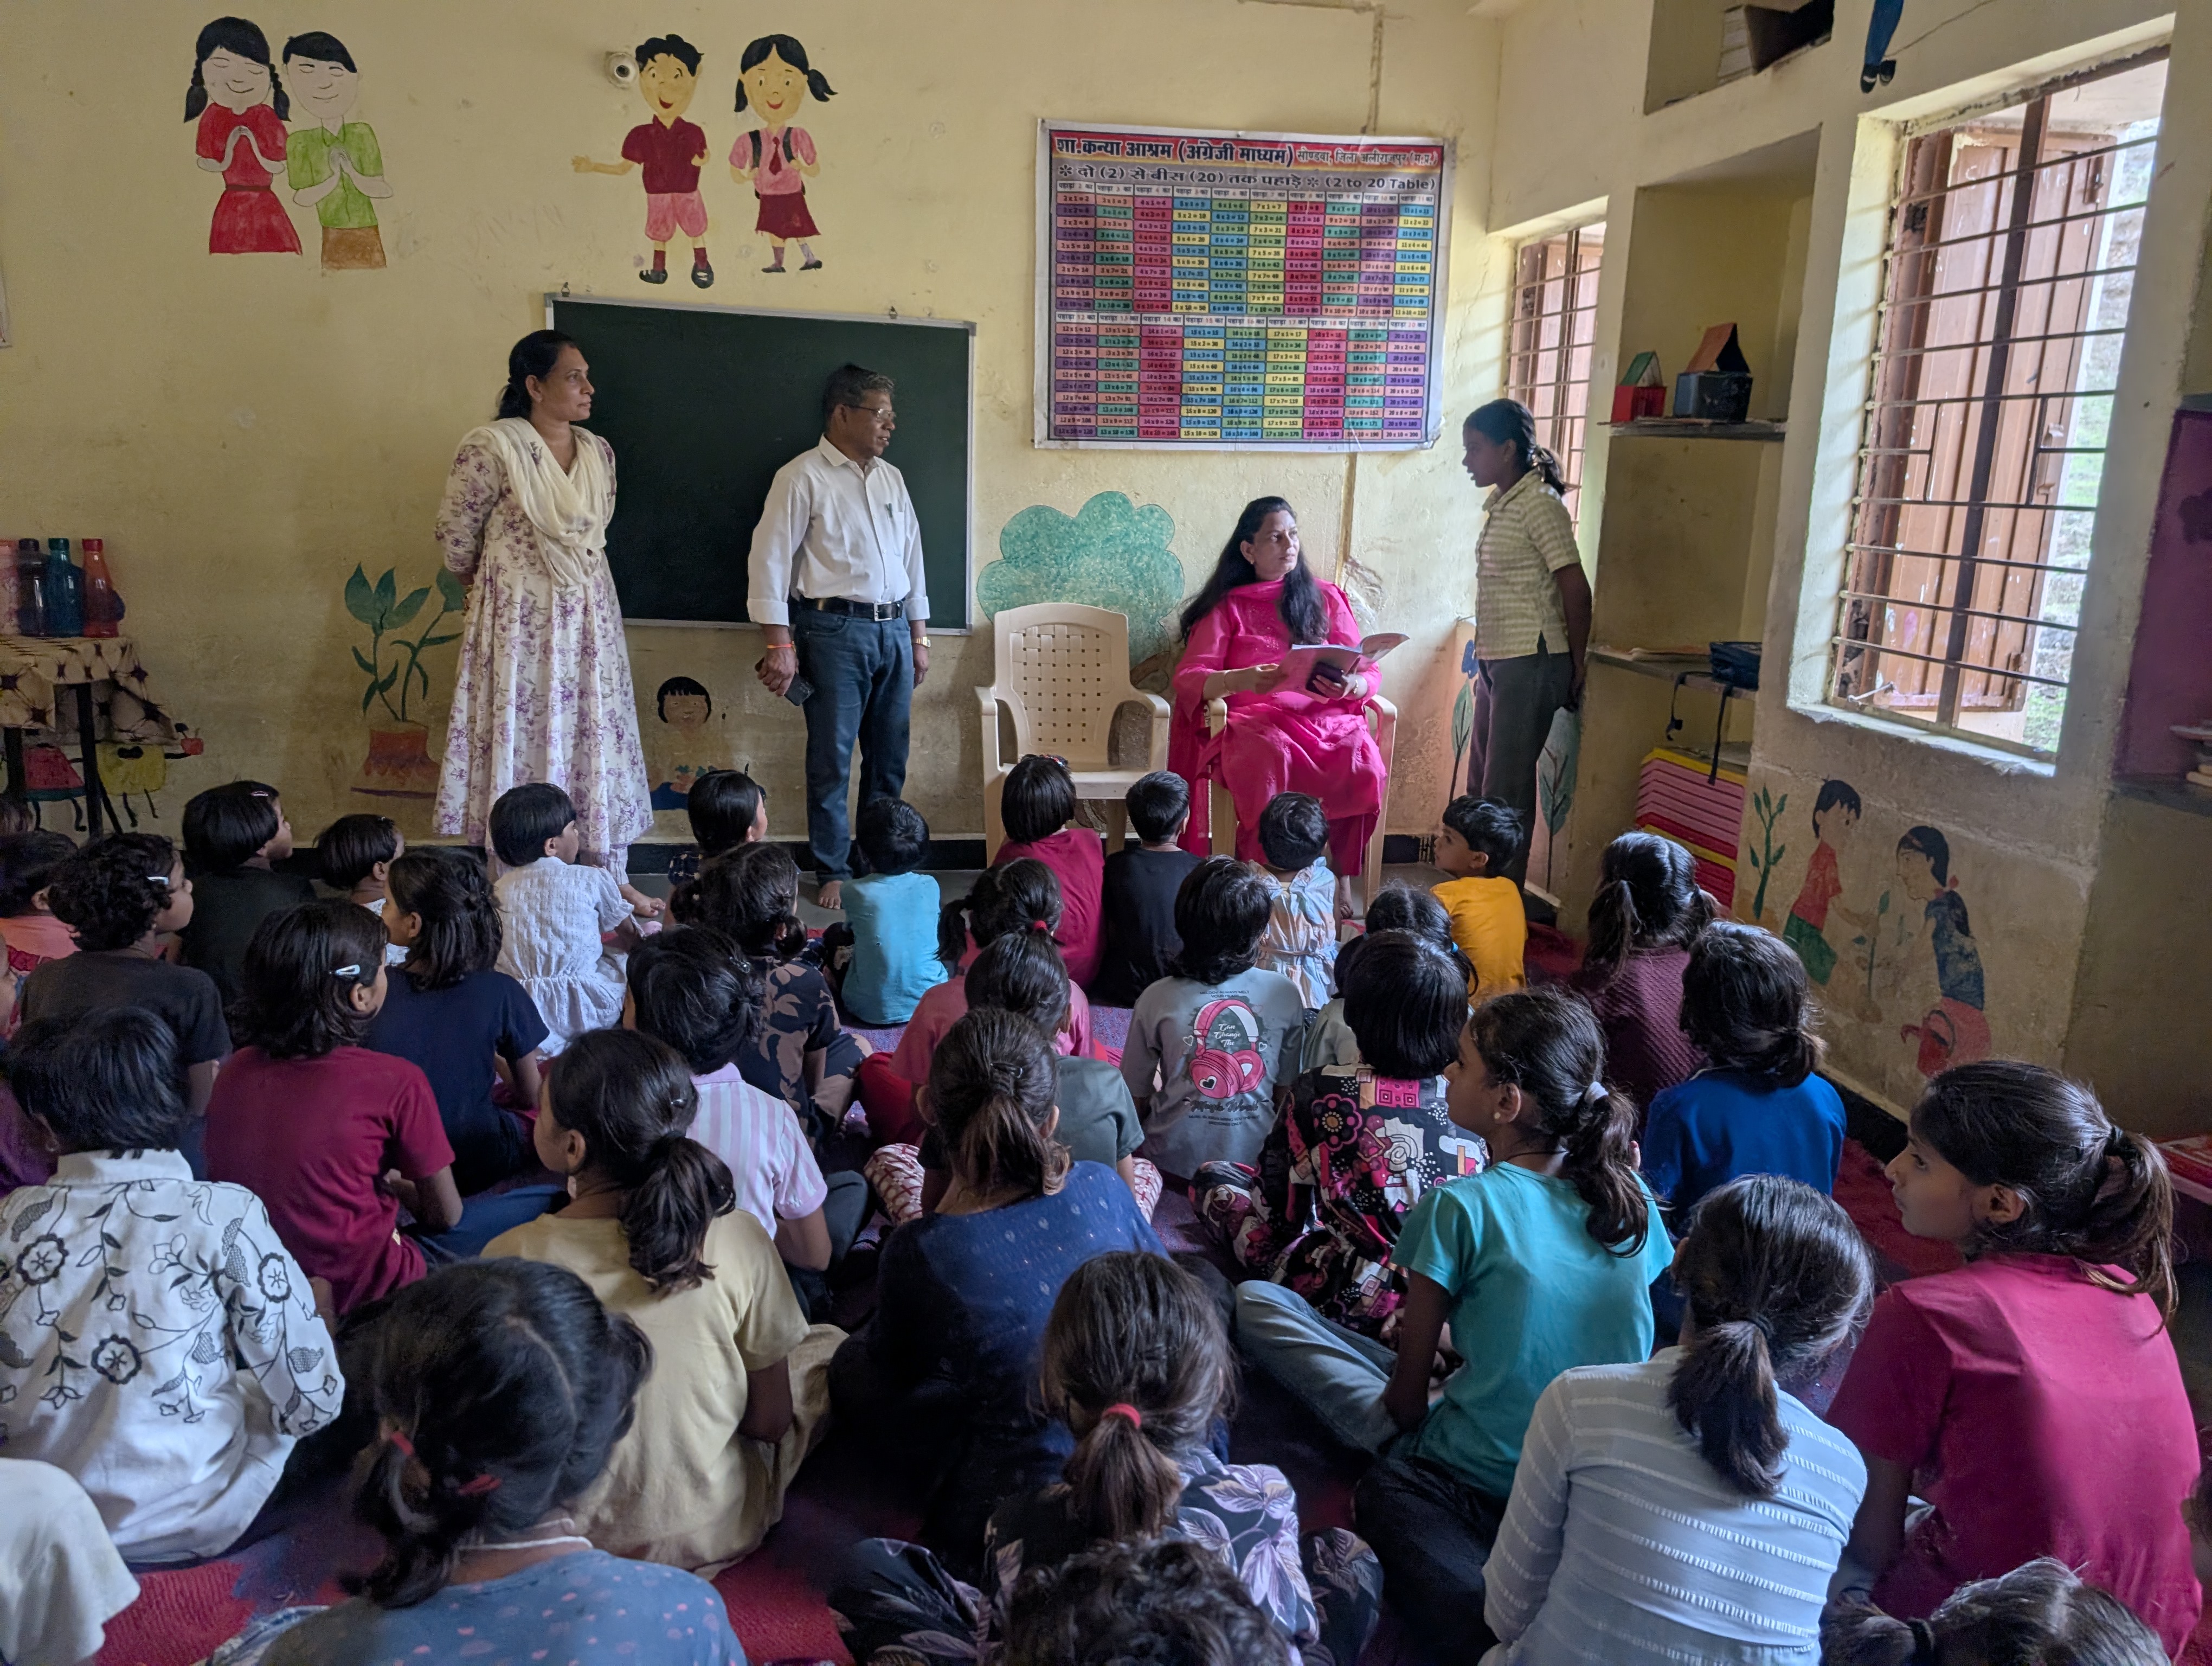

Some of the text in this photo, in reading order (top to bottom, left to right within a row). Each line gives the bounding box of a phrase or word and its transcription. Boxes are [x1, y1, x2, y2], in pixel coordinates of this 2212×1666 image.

[1057, 139, 1121, 156] शा.कन्या
[1126, 142, 1173, 158] आश्रम
[1239, 145, 1293, 167] माध्यम)
[1297, 147, 1331, 163] सोण्डवा,
[1335, 149, 1356, 163] जिला
[1362, 150, 1408, 165] अलीराजपुर
[1078, 165, 1094, 177] दो
[1100, 166, 1124, 179] (2)
[1130, 166, 1145, 180] से
[1190, 171, 1223, 183] (20)
[1229, 174, 1261, 185] तक
[1262, 175, 1302, 189] पहाड़े
[1326, 177, 1342, 188] (2
[1347, 178, 1362, 188] to
[1367, 177, 1385, 188] 20
[1390, 178, 1436, 190] Table)
[1220, 1039, 1235, 1048] The
